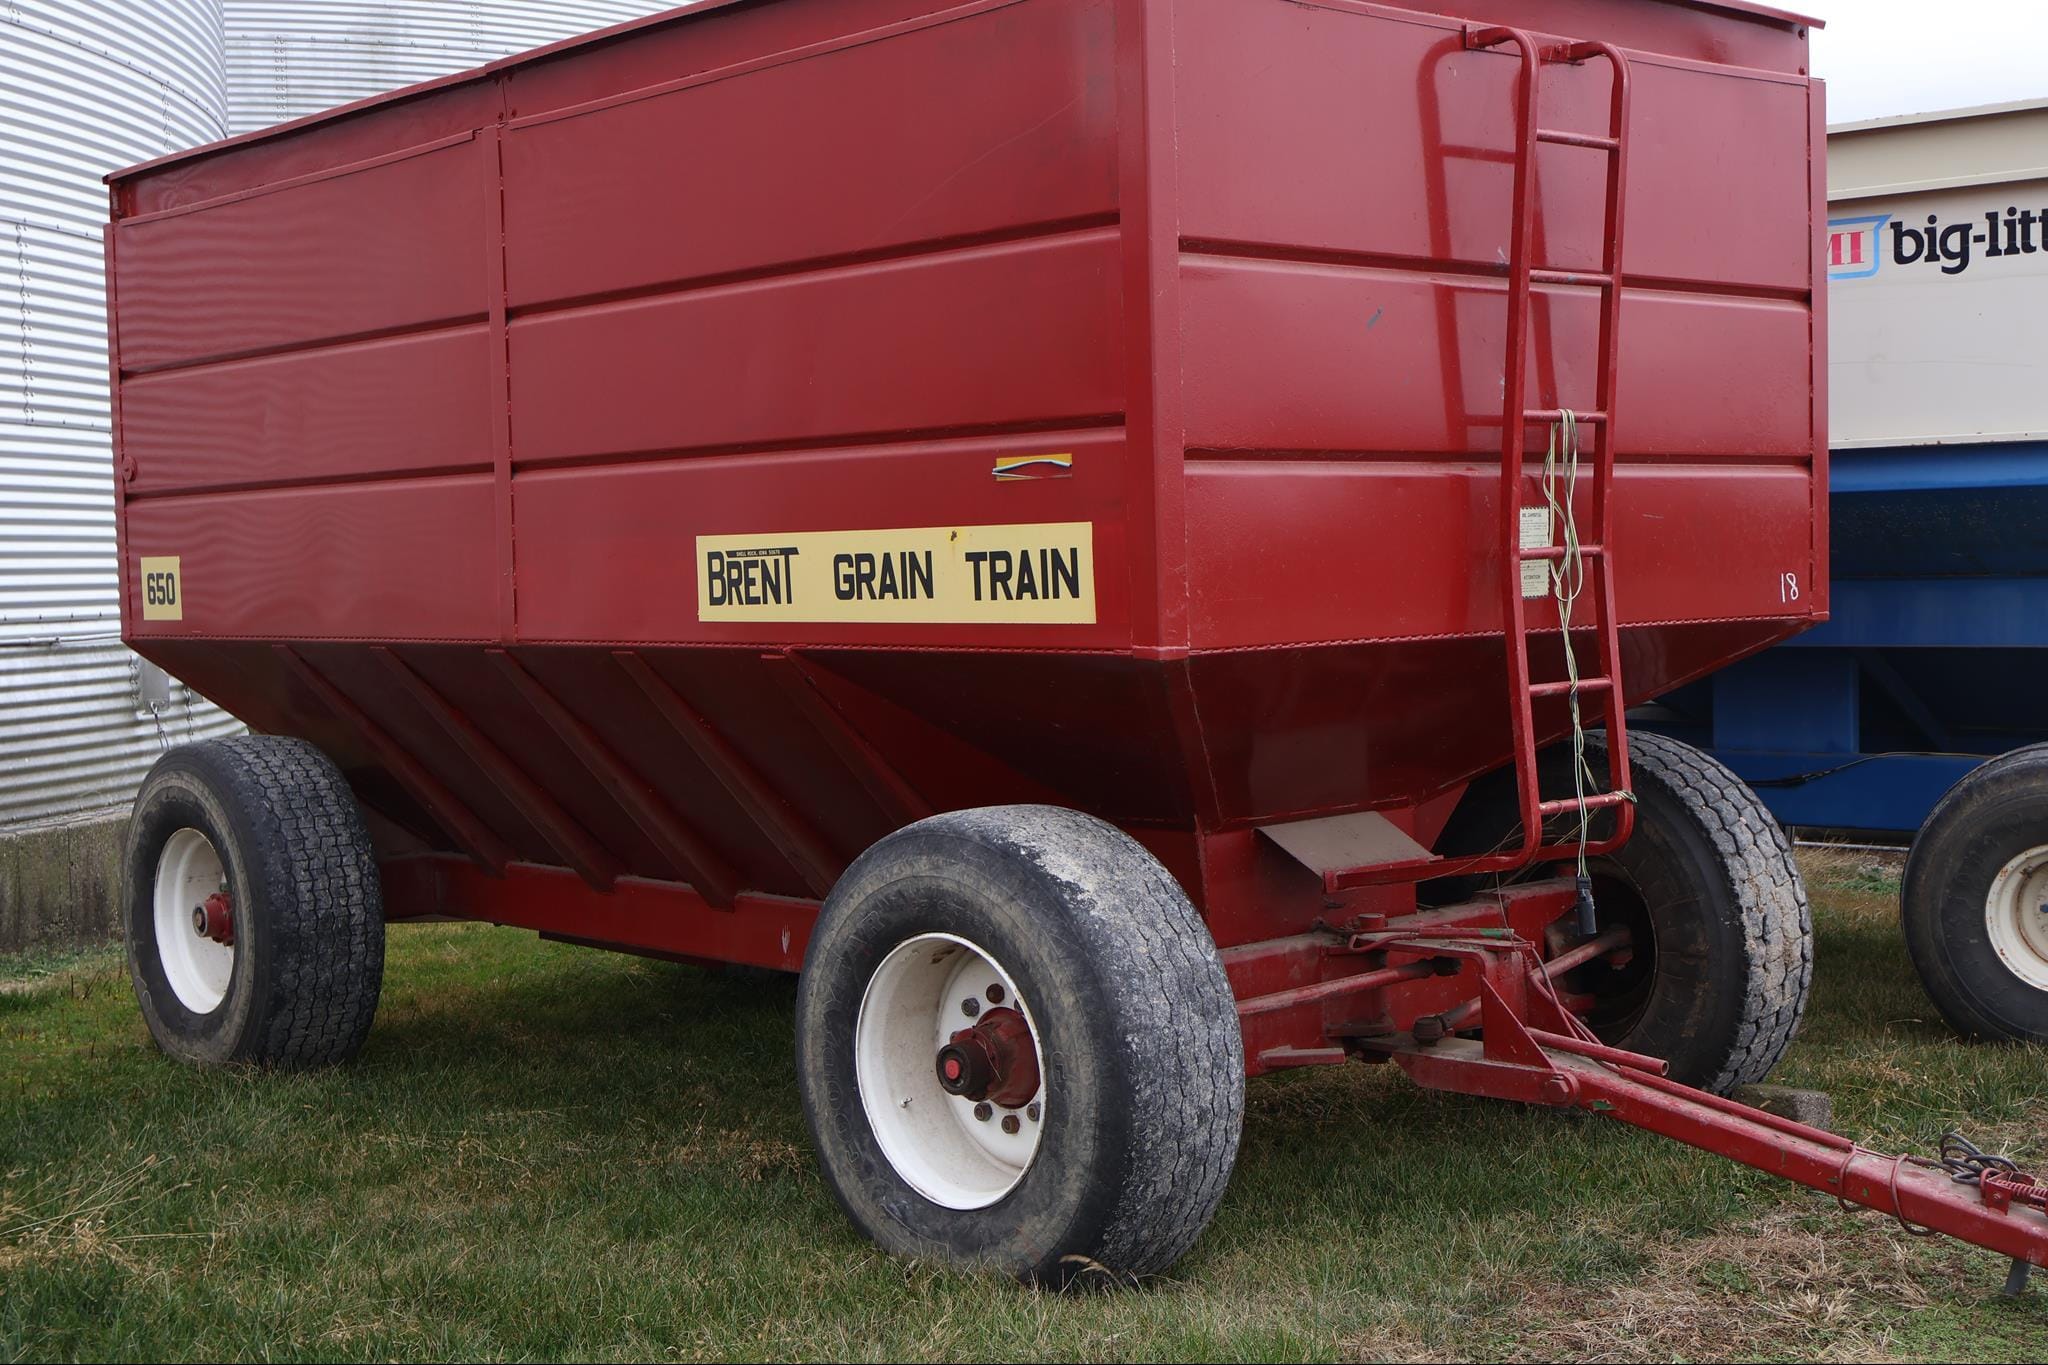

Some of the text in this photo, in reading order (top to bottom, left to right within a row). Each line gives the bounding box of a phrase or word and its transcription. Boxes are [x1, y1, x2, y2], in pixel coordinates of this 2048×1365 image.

[146, 573, 176, 606] 650
[707, 547, 1080, 606] BRENT GRAIN TRAIN
[1780, 572, 1799, 604] 18
